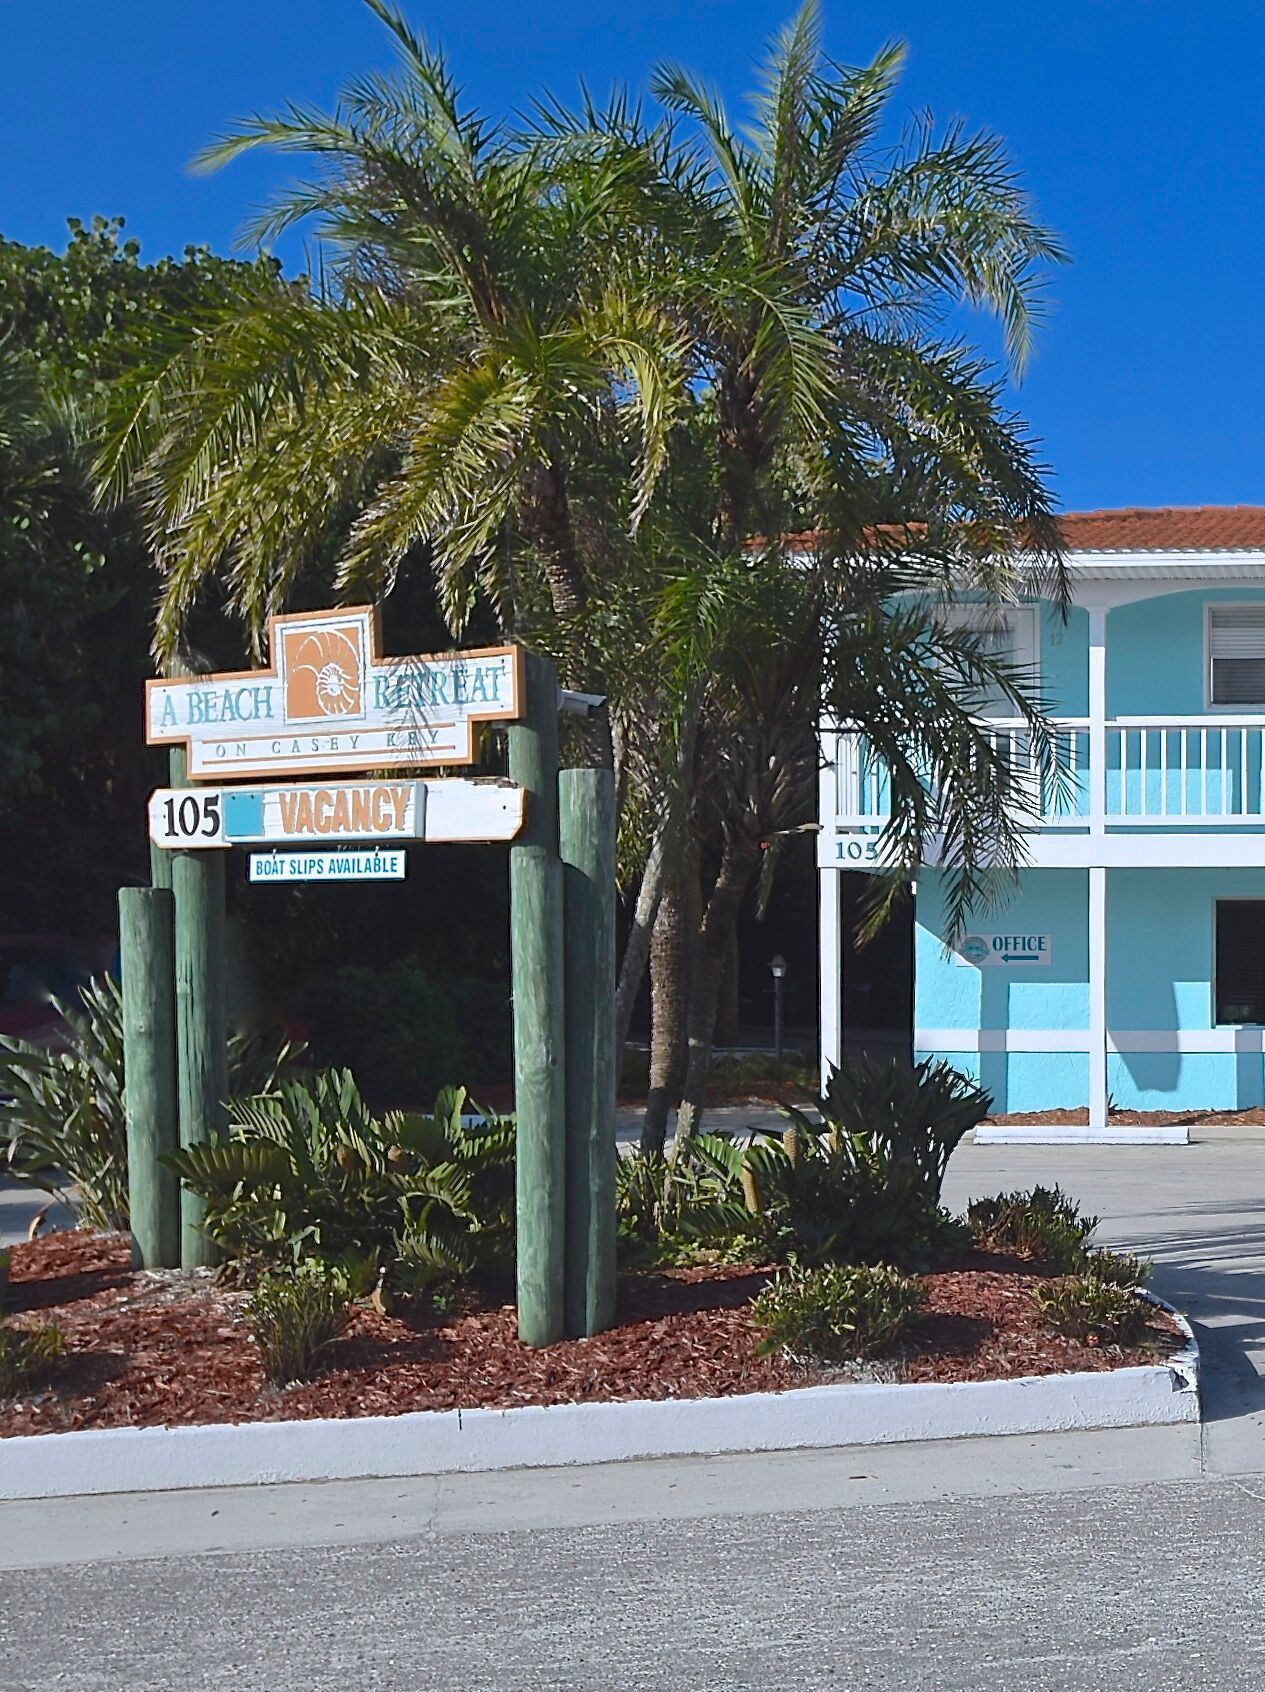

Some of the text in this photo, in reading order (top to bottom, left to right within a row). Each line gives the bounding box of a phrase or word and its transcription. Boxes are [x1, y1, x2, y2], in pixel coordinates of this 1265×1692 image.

[160, 665, 505, 727] A BEACH RETREAT
[215, 730, 439, 758] ON CASEY KEY
[163, 794, 221, 837] 105
[278, 787, 411, 834] VACANCY
[835, 841, 879, 860] 105
[256, 857, 398, 876] BOAT SLIPS AVAILABLE
[992, 936, 1047, 951] OFFICE
